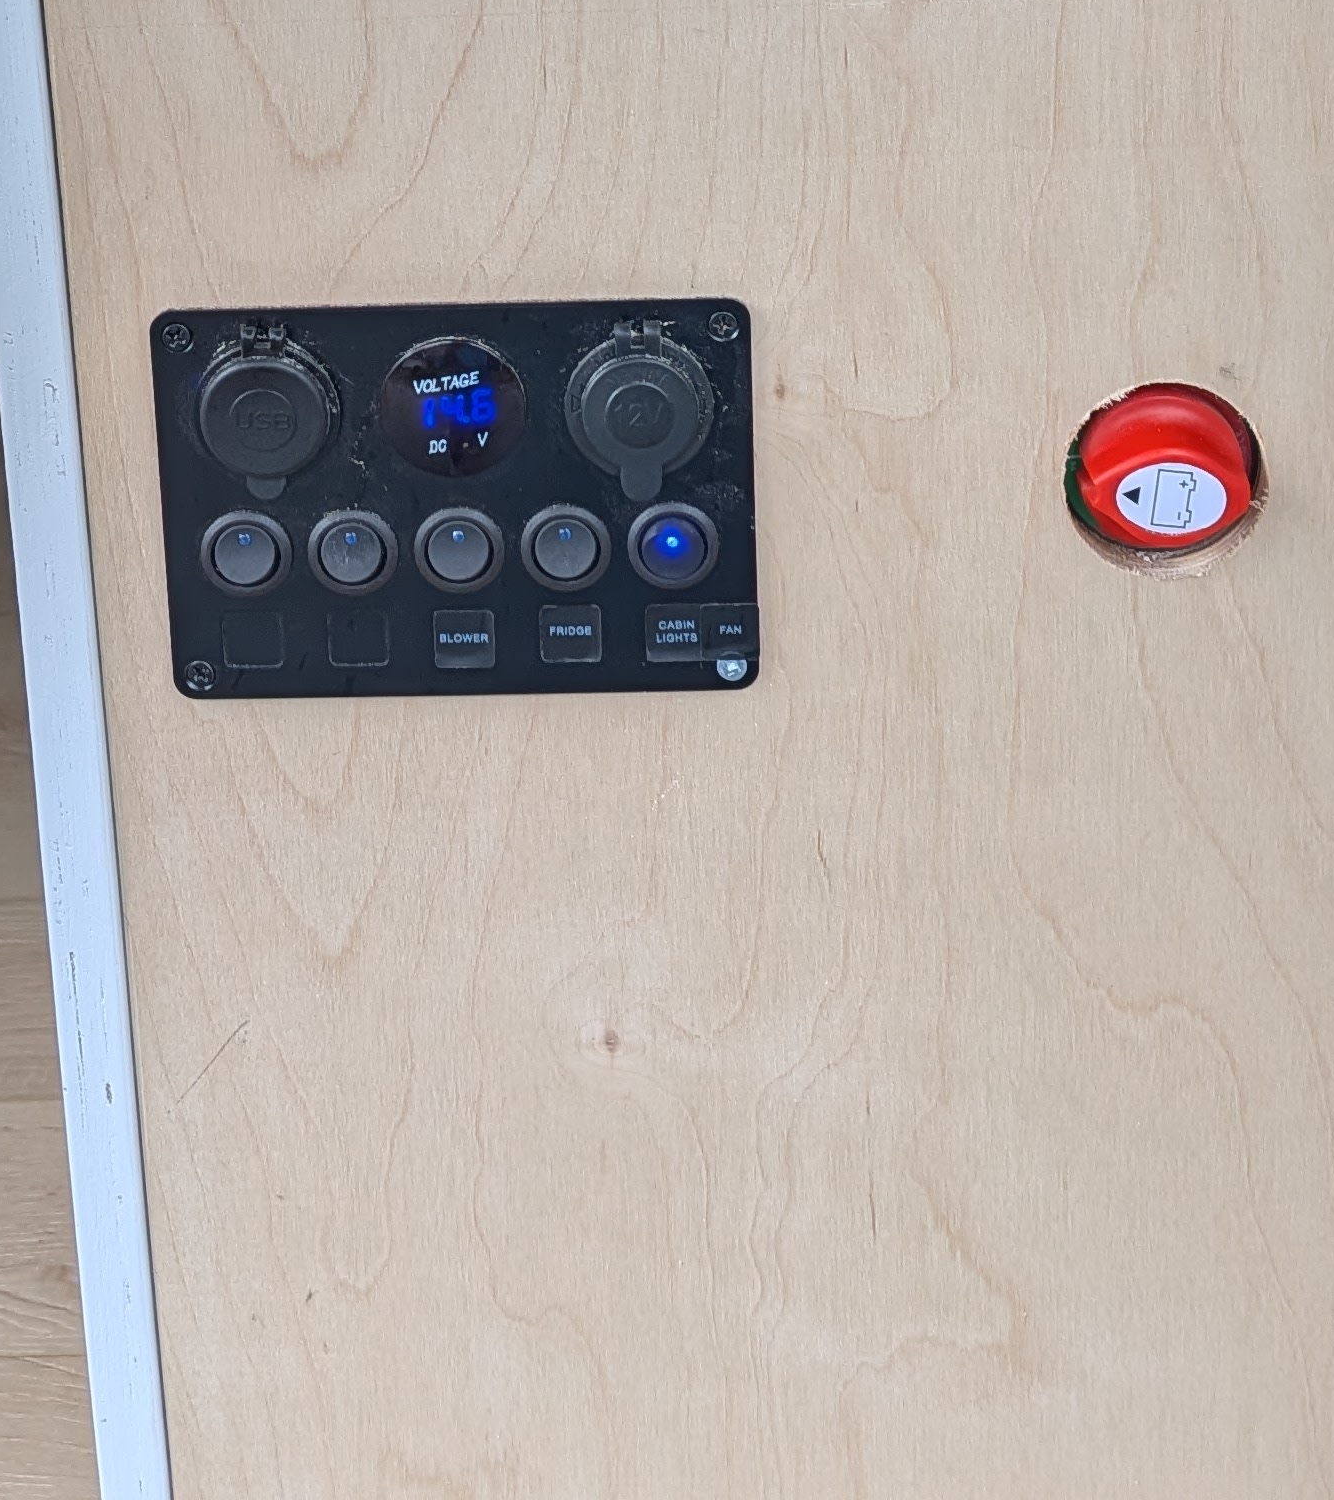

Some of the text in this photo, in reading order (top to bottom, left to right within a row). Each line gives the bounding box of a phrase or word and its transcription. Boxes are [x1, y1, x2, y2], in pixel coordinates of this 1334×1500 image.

[412, 370, 480, 395] VOLTAGE
[235, 411, 292, 430] USB
[613, 402, 665, 427] 12V
[428, 431, 489, 455] DC V
[548, 625, 593, 637] FRIDGE
[657, 619, 696, 631] CABIN
[719, 624, 743, 636] FAN
[439, 632, 490, 645] BLOWER
[655, 631, 699, 644] LIGHTS
